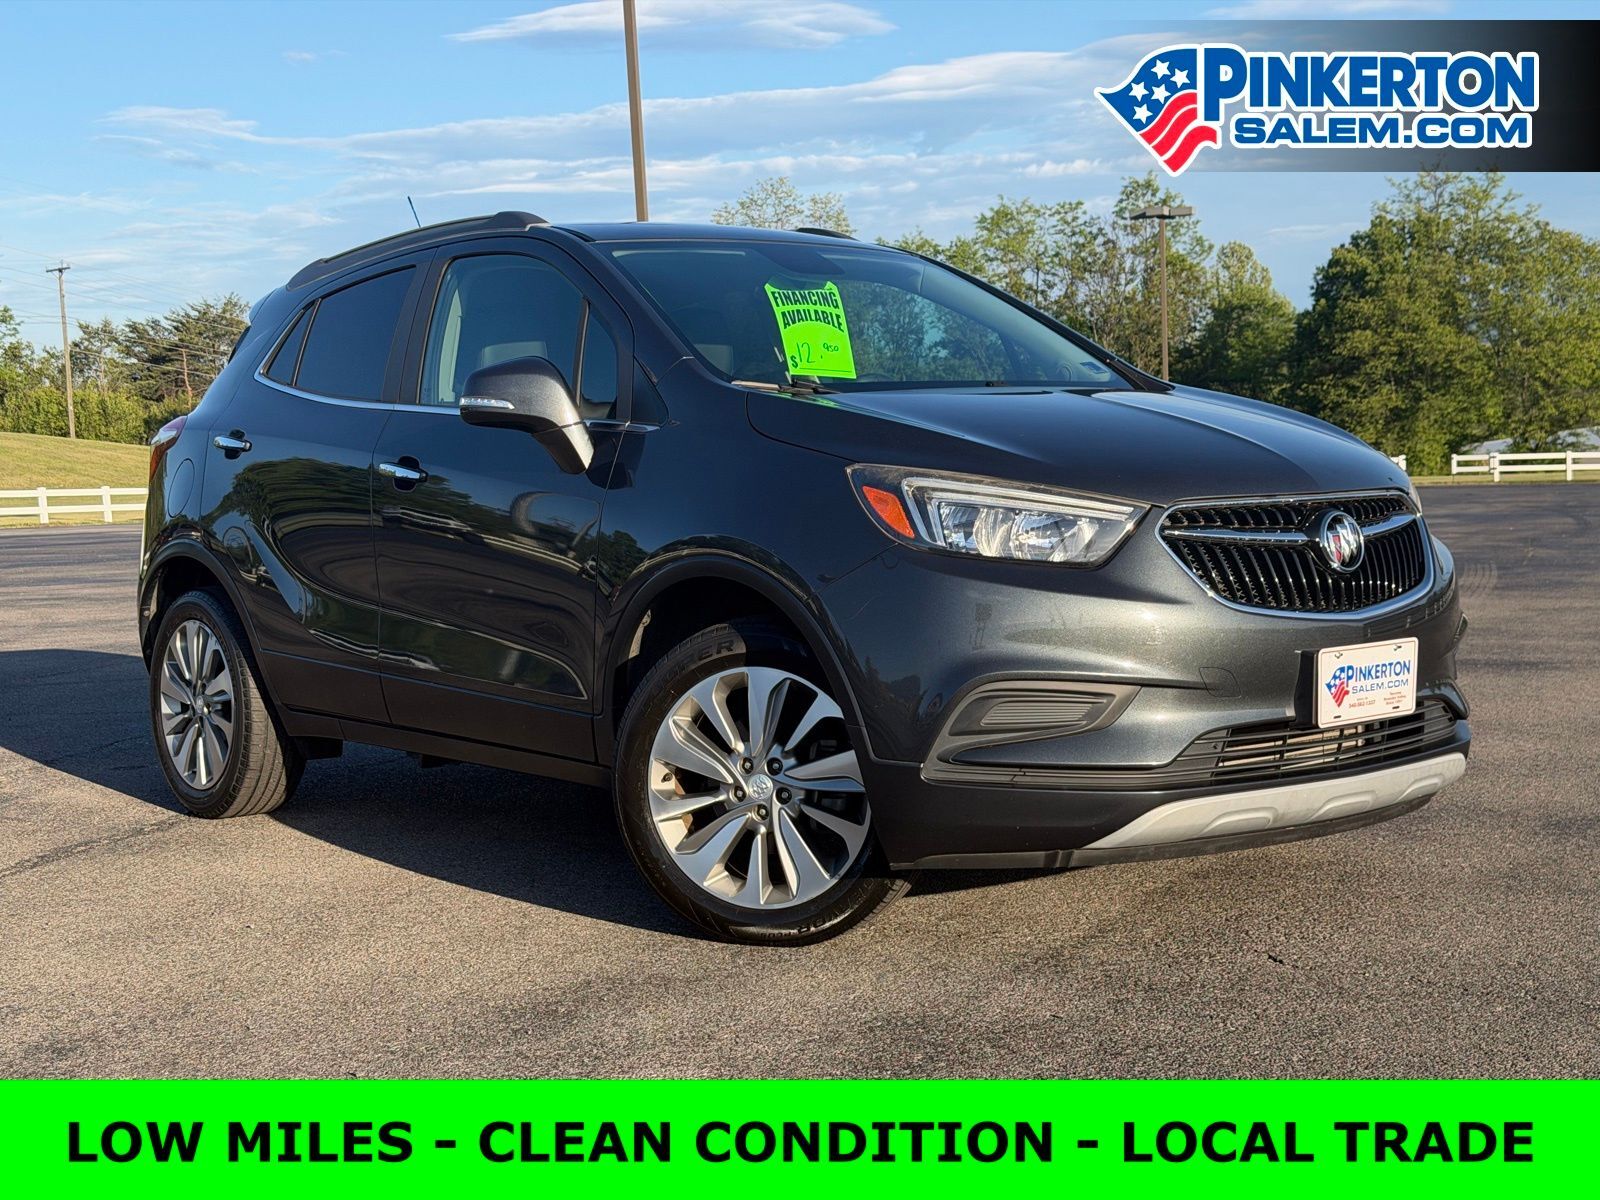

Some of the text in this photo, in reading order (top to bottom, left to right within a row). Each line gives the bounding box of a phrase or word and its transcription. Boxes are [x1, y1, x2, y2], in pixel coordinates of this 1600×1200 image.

[770, 290, 840, 310] FINANCING
[780, 308, 845, 333] AVAILABLE
[1346, 660, 1411, 688] PINKERTON
[1351, 679, 1409, 695] SALEM.COM
